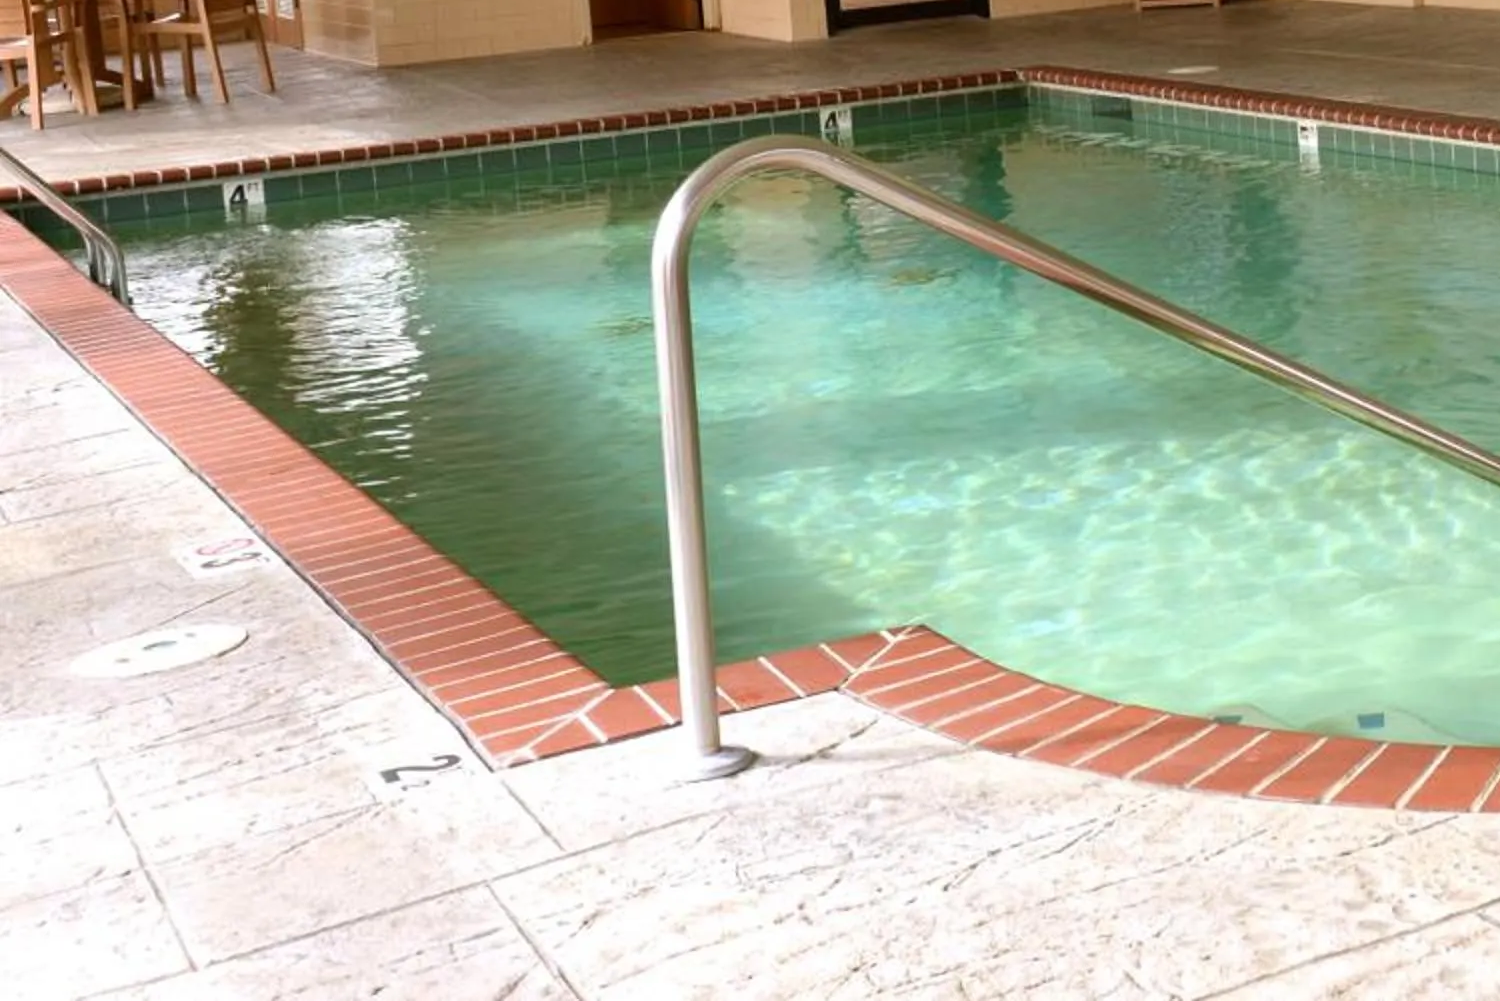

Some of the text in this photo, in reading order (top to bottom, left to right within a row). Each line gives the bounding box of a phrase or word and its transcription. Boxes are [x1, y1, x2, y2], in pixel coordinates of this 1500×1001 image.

[824, 110, 840, 133] 4
[230, 184, 248, 205] 4
[379, 754, 462, 784] 2
